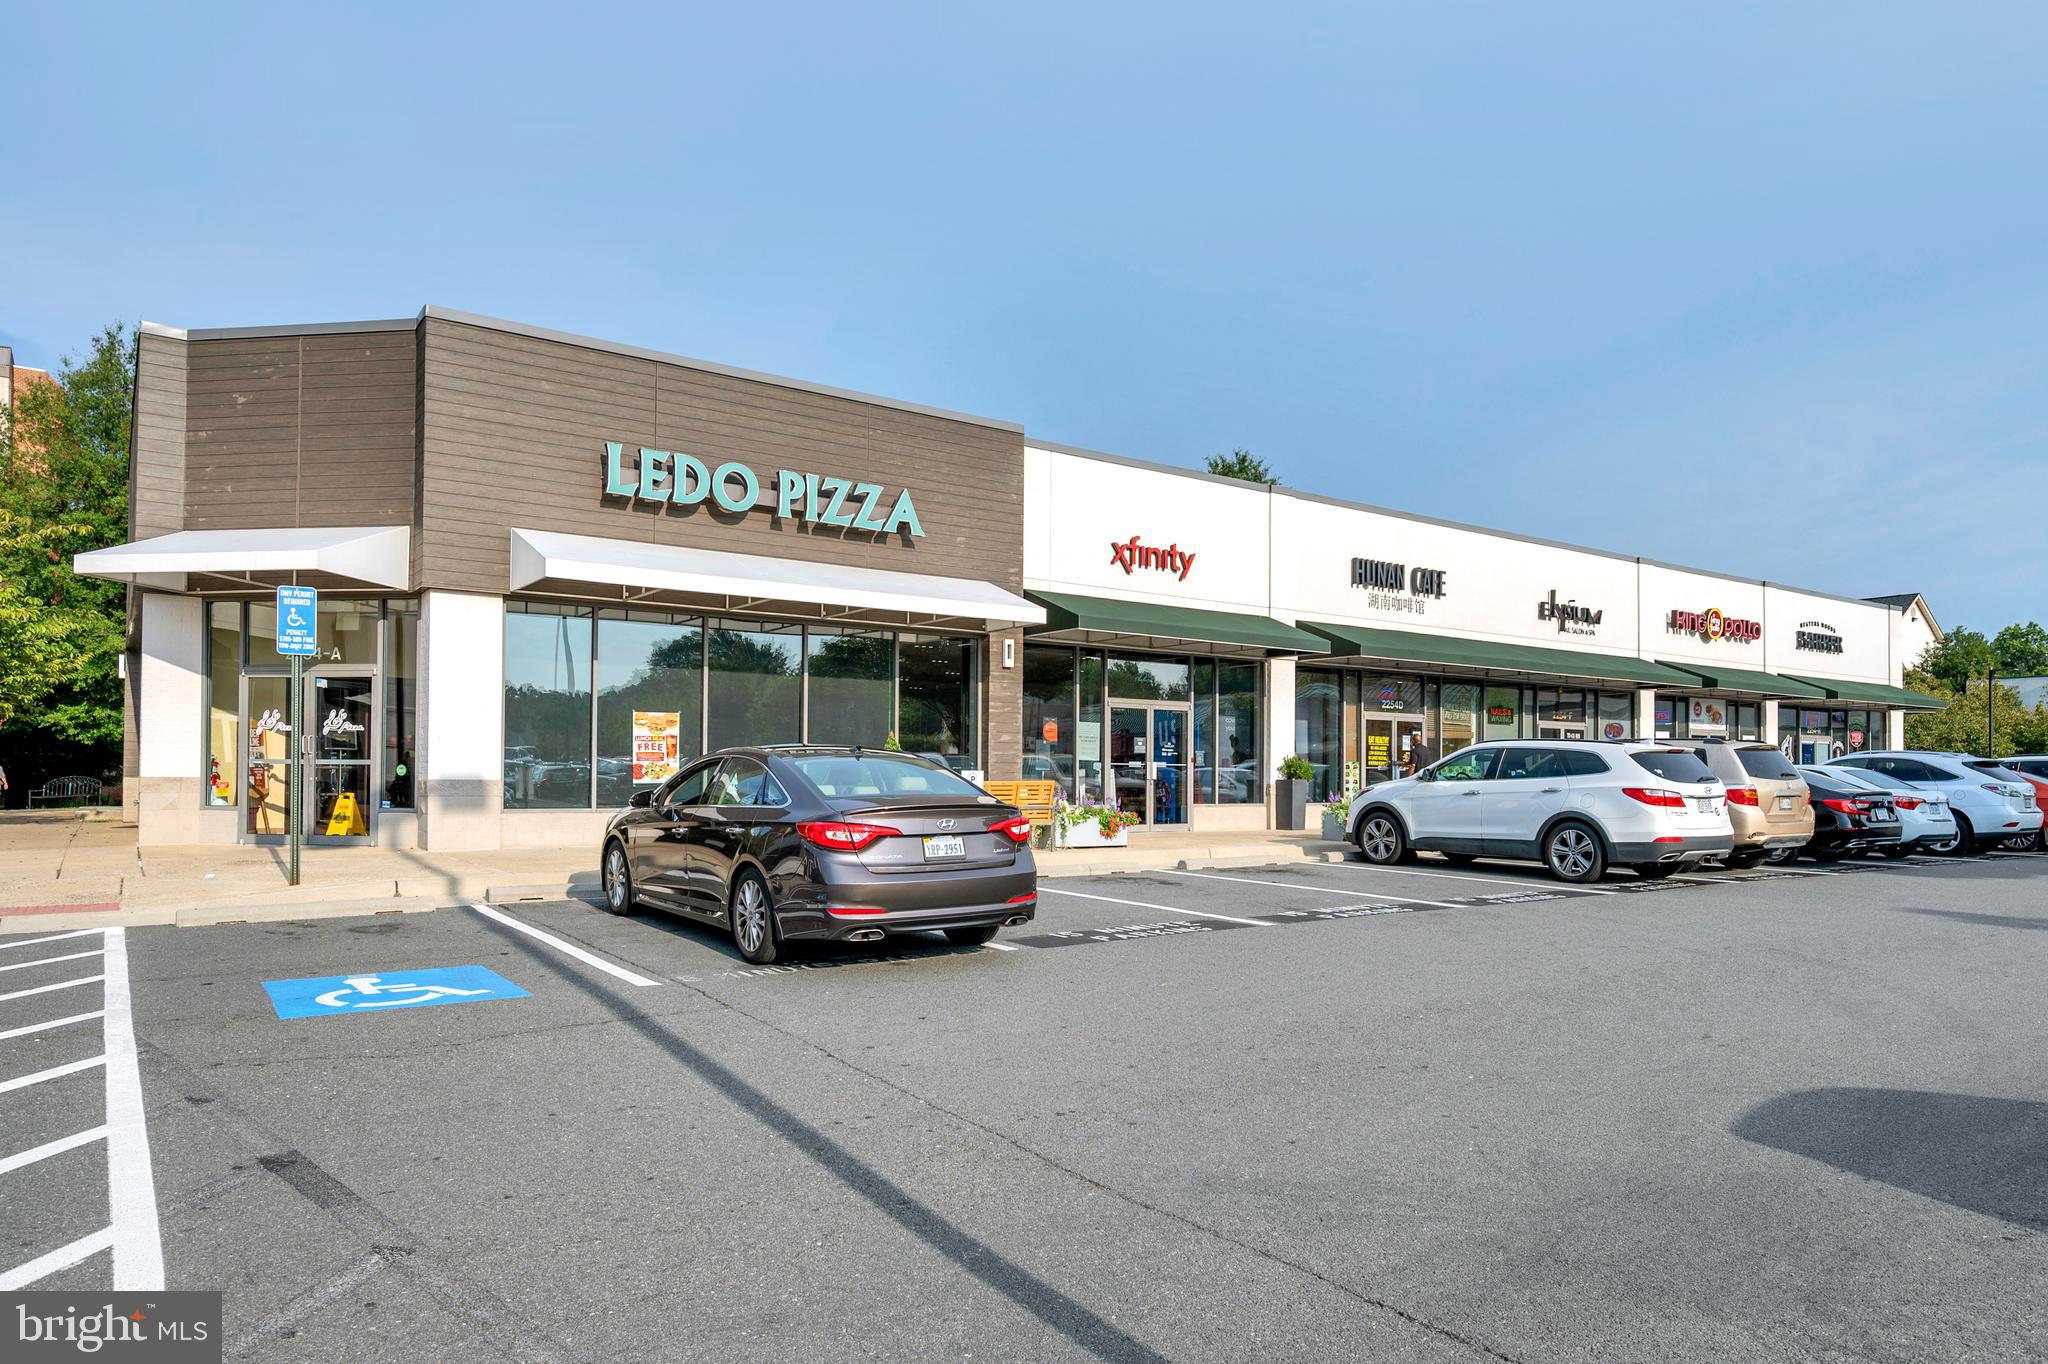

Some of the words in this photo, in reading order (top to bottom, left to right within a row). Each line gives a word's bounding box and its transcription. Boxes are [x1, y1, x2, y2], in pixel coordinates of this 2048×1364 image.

[604, 441, 760, 512] LEDO
[777, 469, 927, 538] PIZZA
[1110, 536, 1196, 582] xfinity
[1351, 557, 1405, 593] HUNAN
[294, 590, 314, 599] PERMIT
[283, 598, 311, 606] REQUIRED
[1368, 592, 1425, 614] 湖南咖啡馆
[1382, 700, 1404, 710] 2254D
[637, 742, 663, 751] FREE
[1090, 926, 1213, 942] PARKING
[1094, 921, 1201, 934] MINUTE
